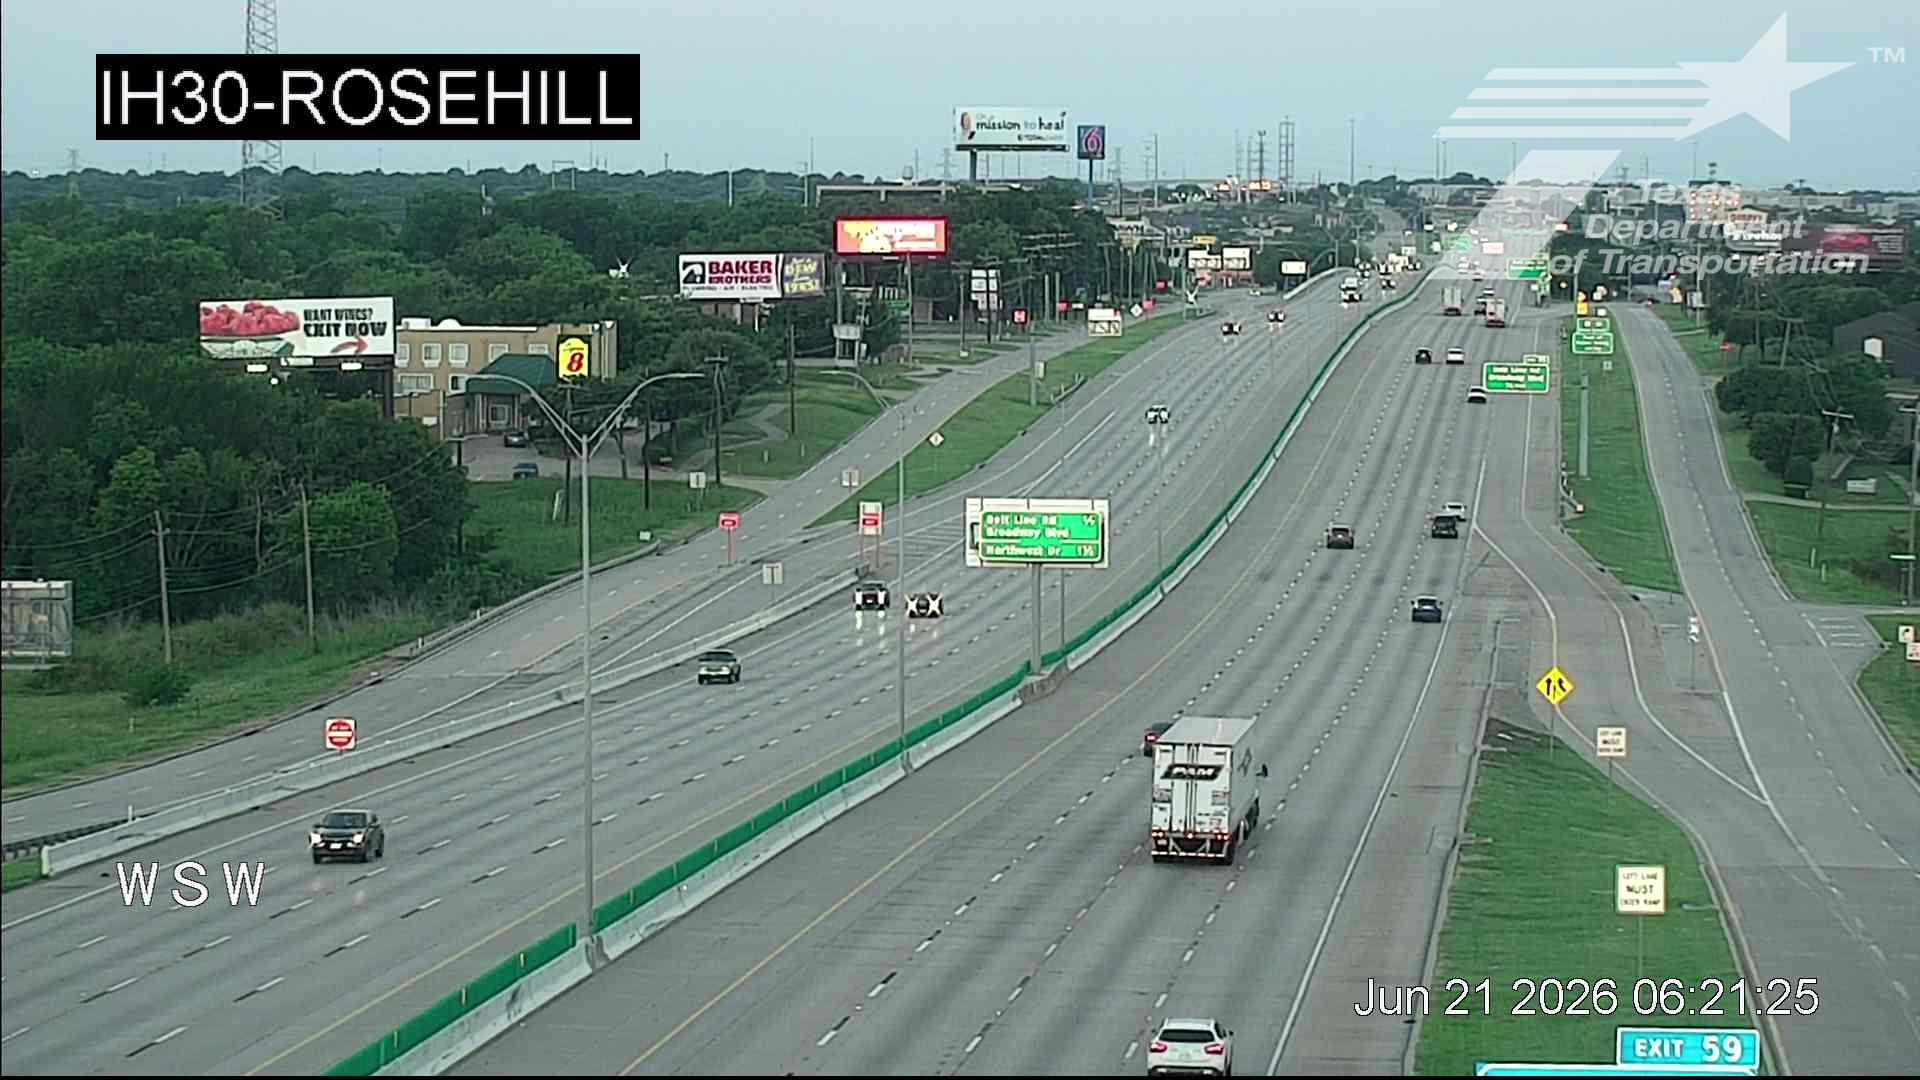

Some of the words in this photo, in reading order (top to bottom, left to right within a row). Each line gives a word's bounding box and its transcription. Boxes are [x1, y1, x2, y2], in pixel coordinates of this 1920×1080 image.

[976, 119, 1020, 130] mission
[1024, 120, 1037, 130] to
[1038, 116, 1064, 130] heal
[709, 261, 772, 274] BAKER
[709, 275, 771, 284] BROTHERS
[303, 309, 331, 322] WANT
[334, 308, 373, 321] WINGS?
[303, 323, 341, 337] EXIT
[345, 321, 387, 337] NOW
[567, 352, 585, 373] 8
[986, 514, 1011, 525] Belt
[1014, 514, 1037, 525] Line
[986, 527, 1042, 538] Broadway
[986, 545, 1043, 556] Northwest
[1047, 546, 1061, 556] Dr
[1626, 884, 1654, 894] MUST
[1635, 1038, 1684, 1057] EXIT
[1702, 1035, 1742, 1062] 59
